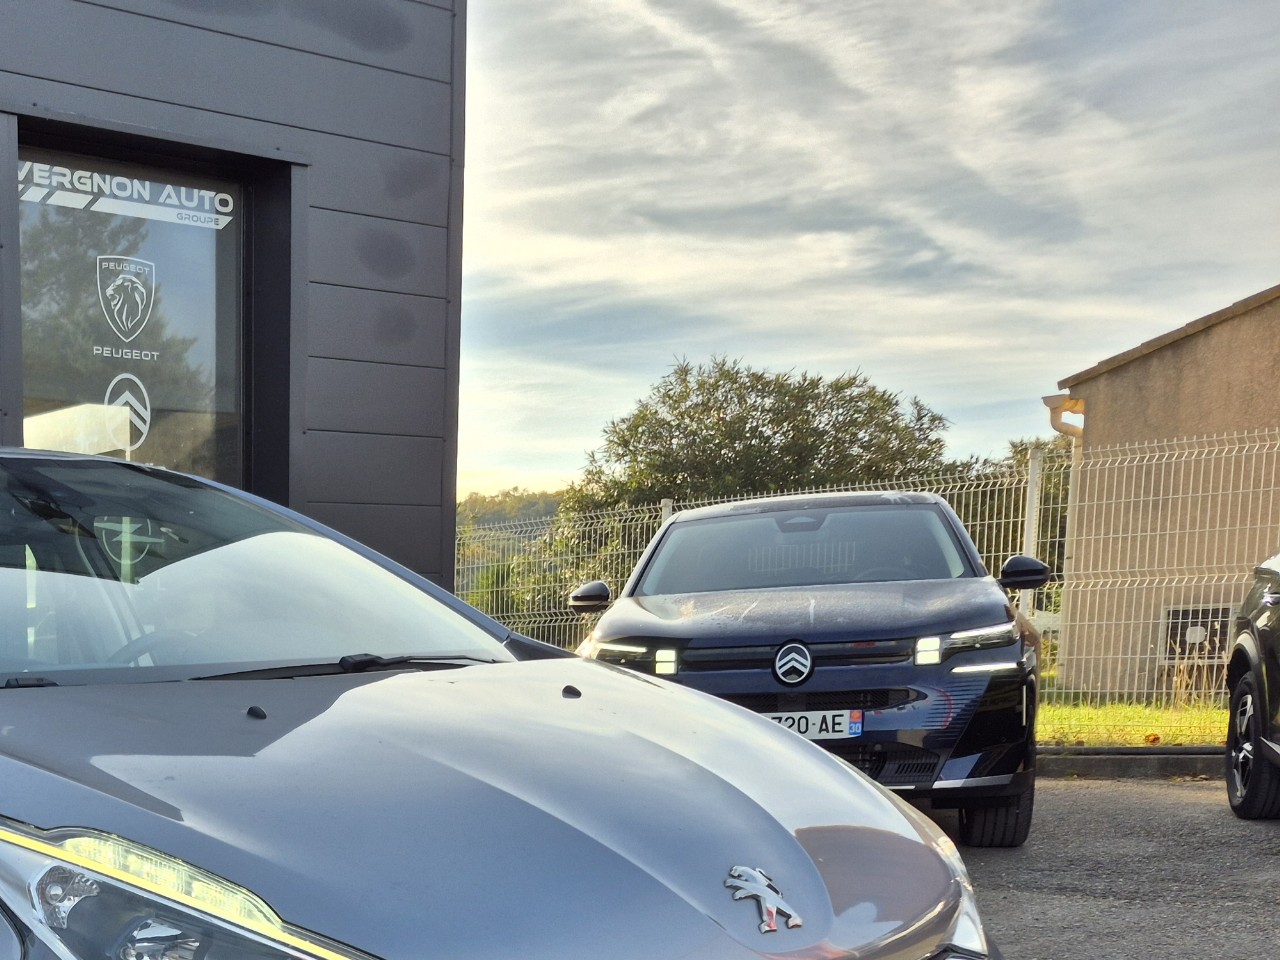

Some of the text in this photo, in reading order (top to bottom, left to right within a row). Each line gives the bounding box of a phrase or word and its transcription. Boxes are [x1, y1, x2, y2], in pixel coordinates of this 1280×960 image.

[18, 161, 234, 213] VERGNON AUTO
[176, 213, 220, 226] GROUPE
[101, 262, 150, 275] PEUGEOT
[93, 346, 160, 361] PEUGEOT
[849, 723, 861, 733] 30
